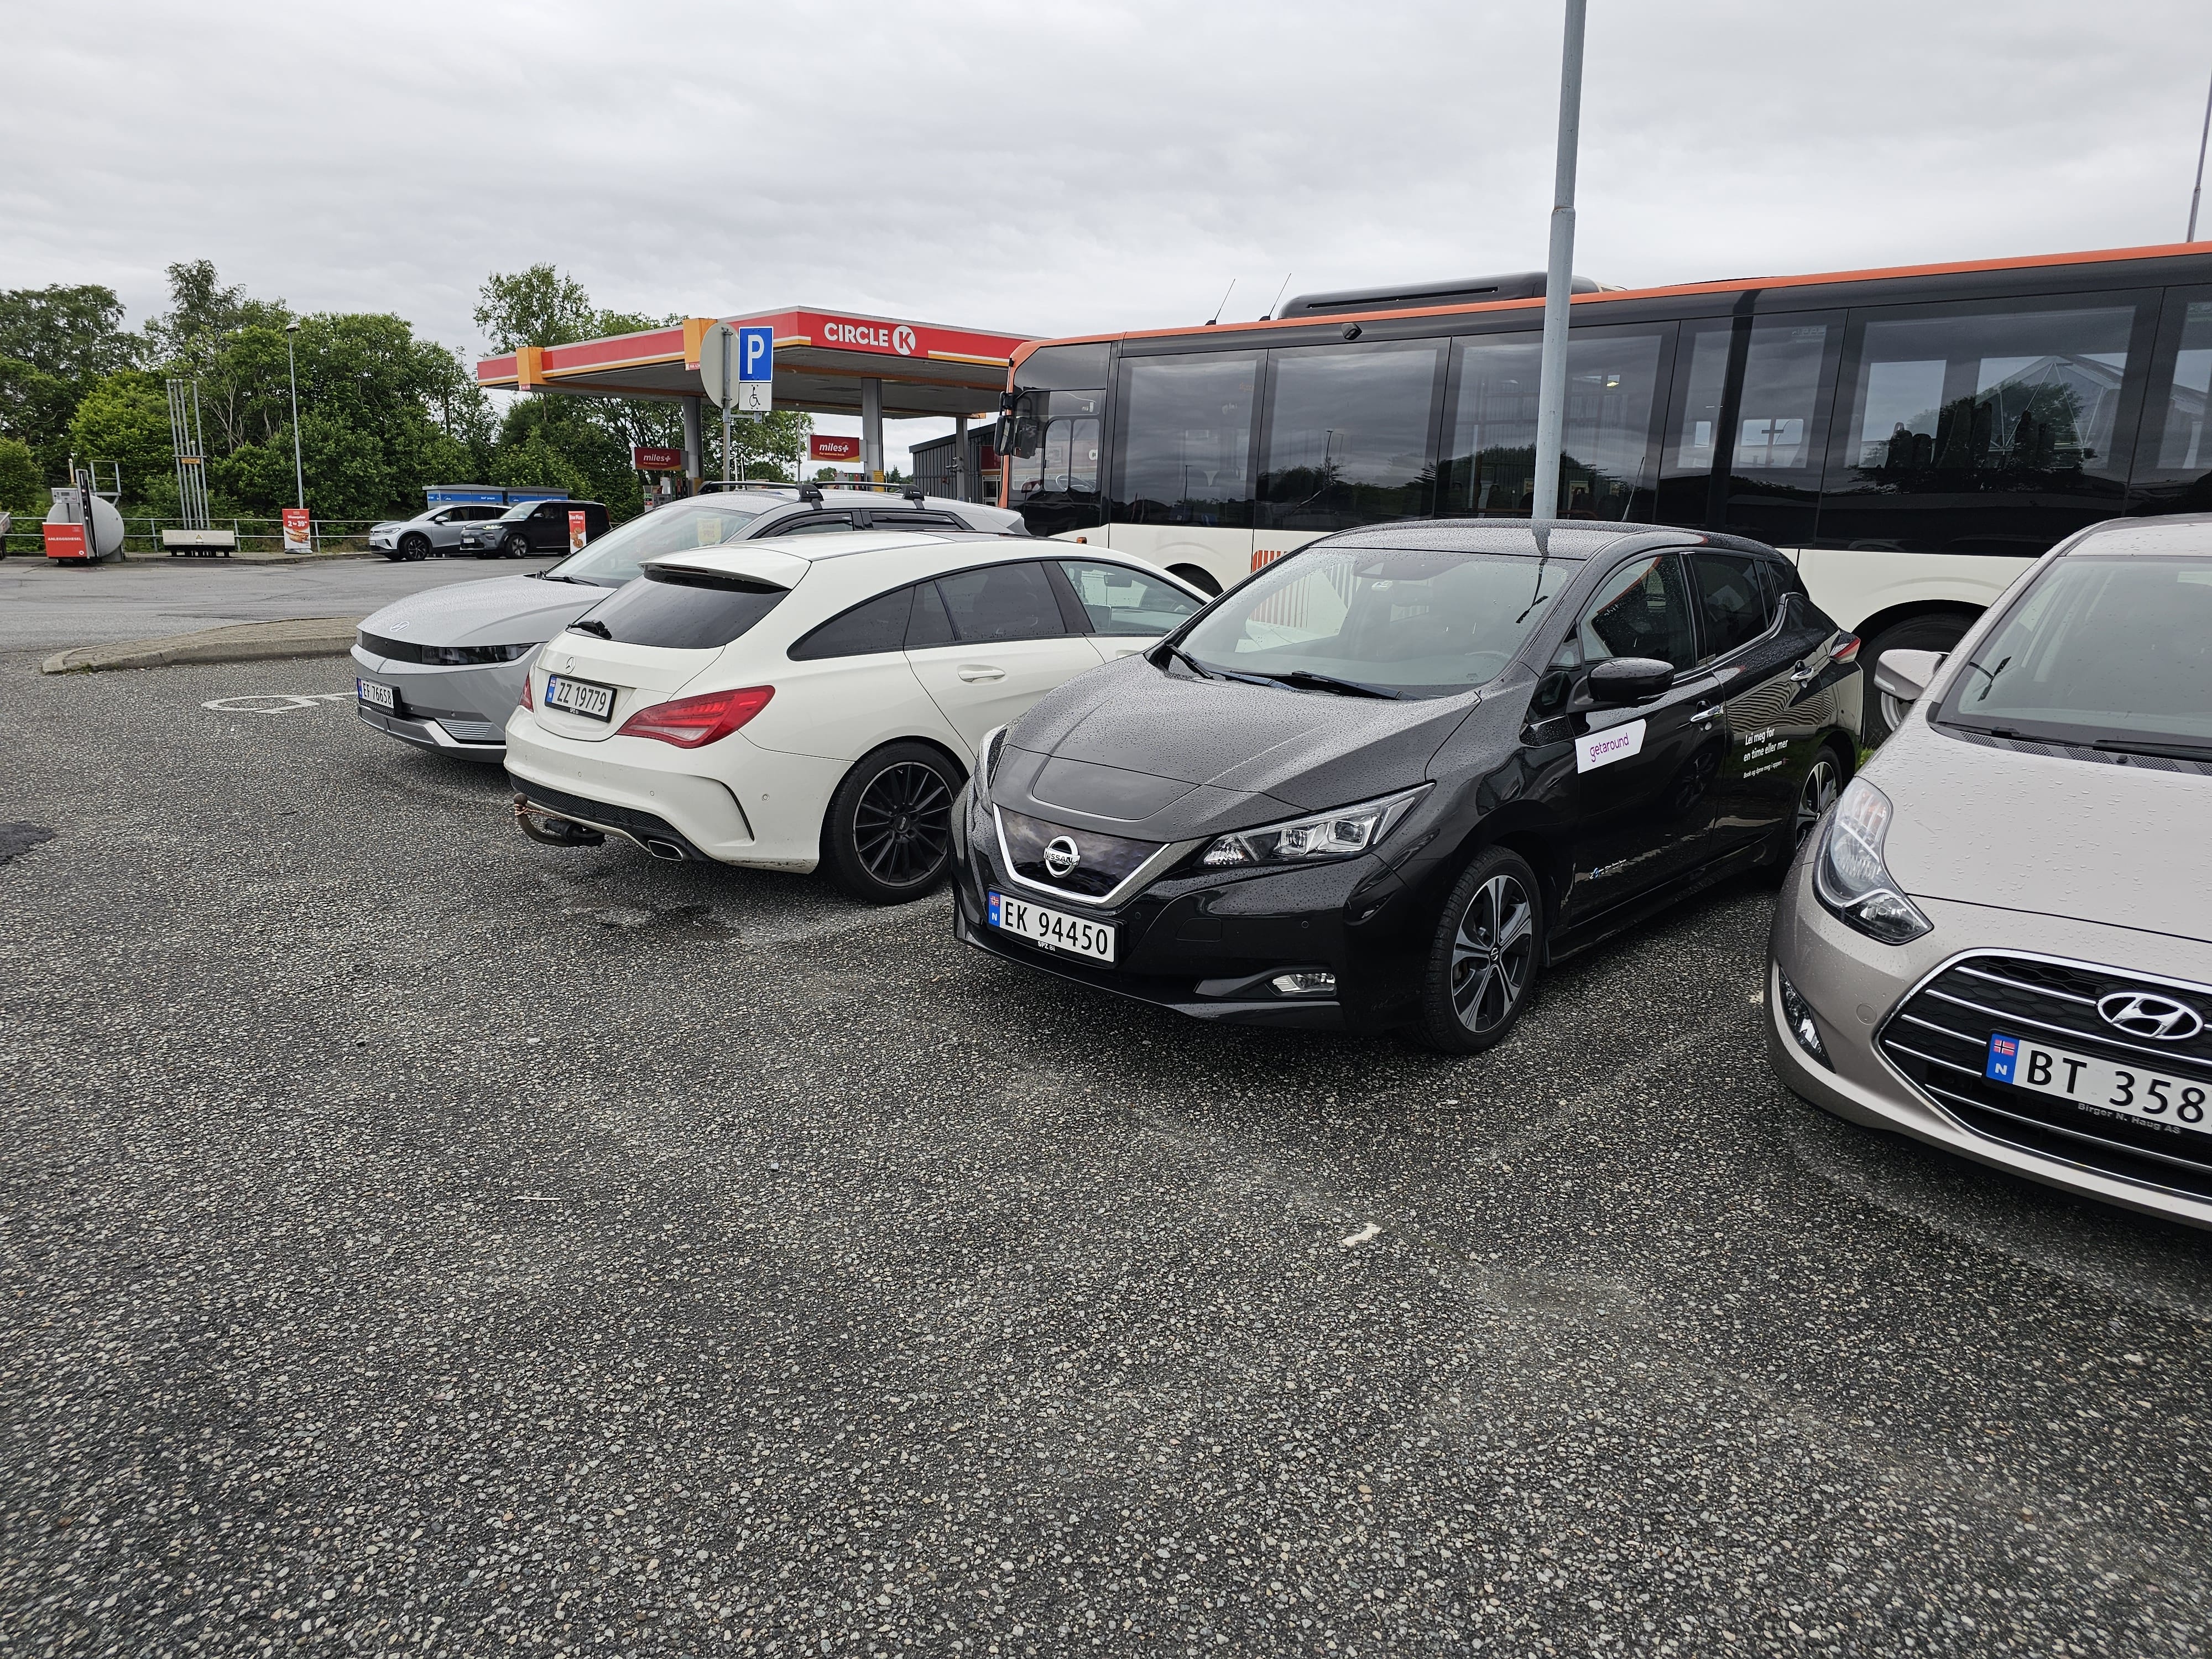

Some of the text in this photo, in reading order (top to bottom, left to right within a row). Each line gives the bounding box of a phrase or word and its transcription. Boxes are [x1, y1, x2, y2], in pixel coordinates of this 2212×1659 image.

[824, 322, 915, 354] CIRCLE K
[748, 335, 764, 374] P
[363, 683, 392, 705] EF 76658
[557, 682, 607, 712] ZZ 19779
[1590, 732, 1629, 762] getaround
[1745, 727, 1775, 745] Lei meg for
[1744, 740, 1788, 762] en time eller mer
[1045, 851, 1073, 863] NISSAN
[992, 912, 998, 921] N
[1005, 901, 1108, 955] EK 94450
[1037, 941, 1049, 950] SPZ
[1995, 1063, 2007, 1076] N
[2026, 1050, 2212, 1127] BT 358
[2078, 1103, 2182, 1134] Birger N. Haug AS
